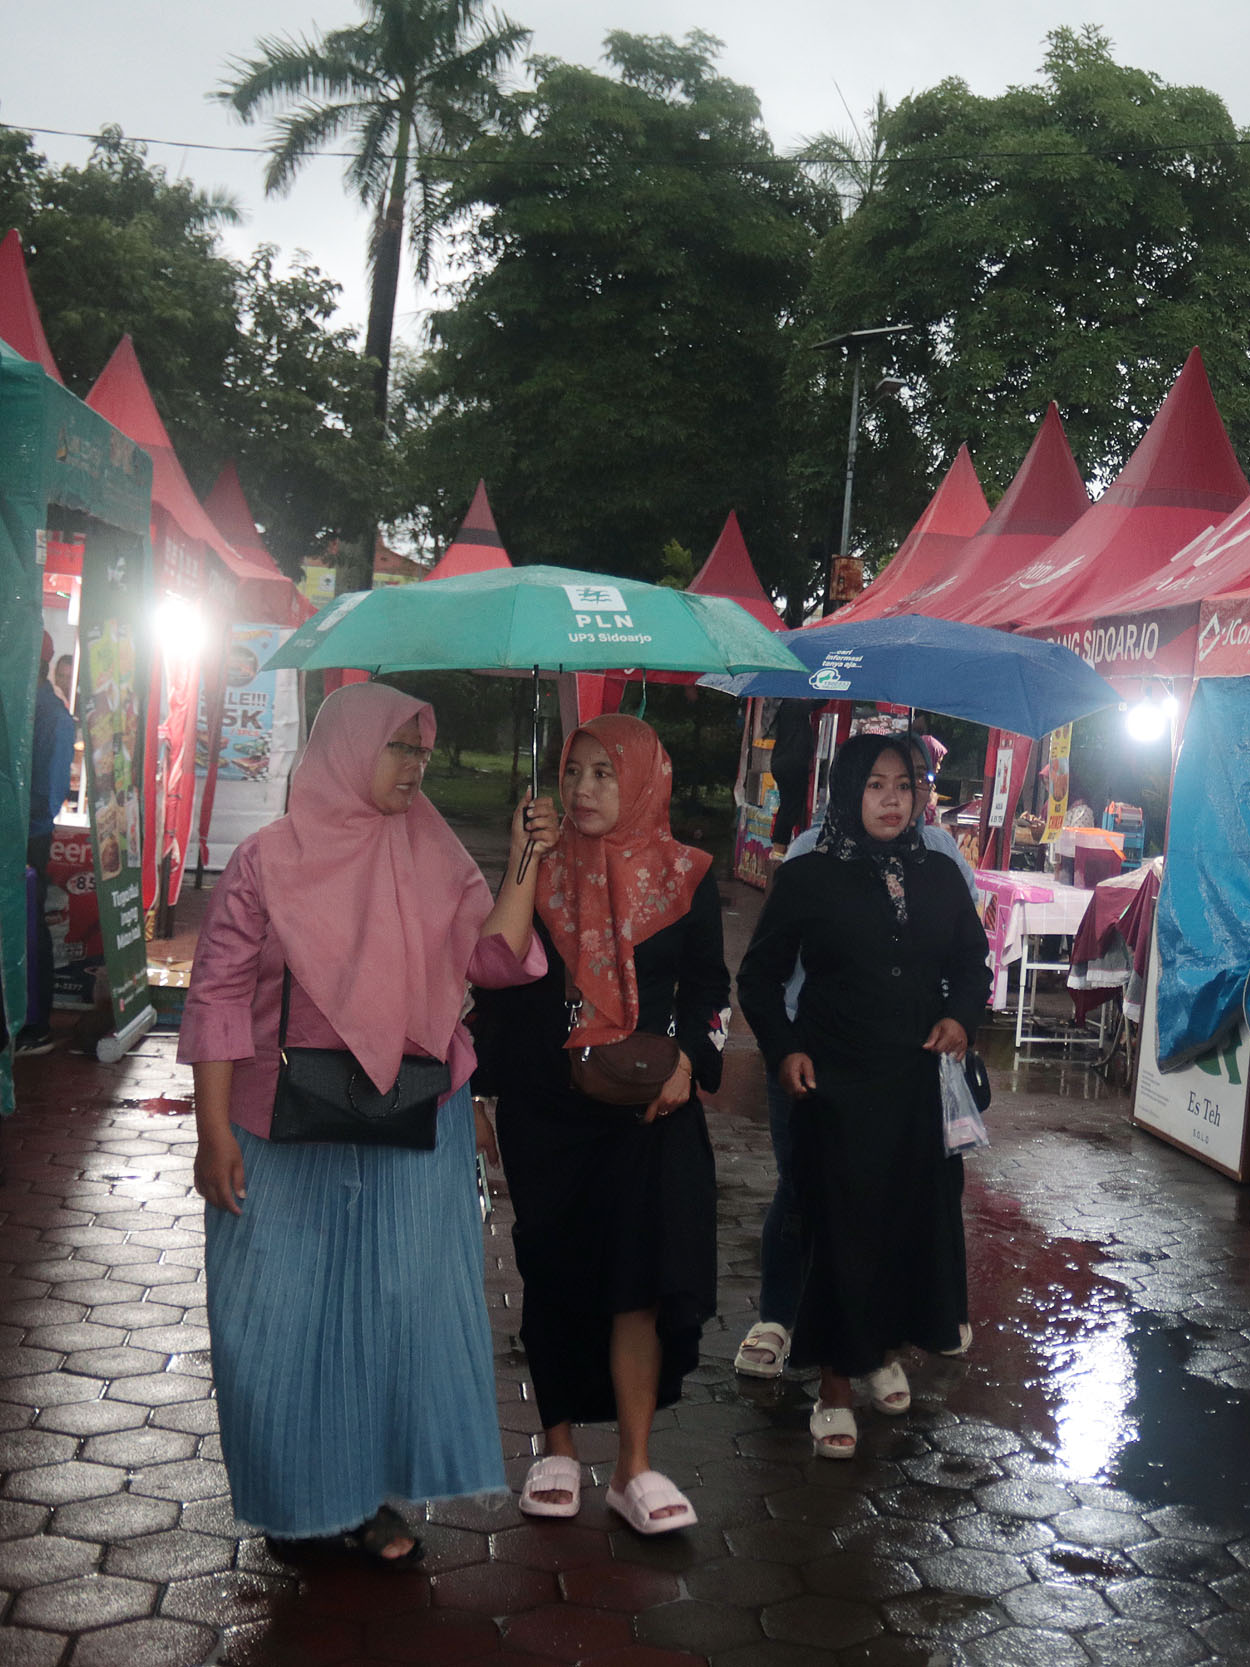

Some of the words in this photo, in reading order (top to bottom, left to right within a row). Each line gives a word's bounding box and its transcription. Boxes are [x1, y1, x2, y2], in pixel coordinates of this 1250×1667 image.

[575, 614, 634, 628] PLN
[568, 632, 595, 643] UP3
[598, 632, 652, 644] Sidoarjo
[1082, 622, 1160, 664] SIDOARJO
[1187, 1090, 1201, 1116] Es
[1203, 1098, 1221, 1127] Teh
